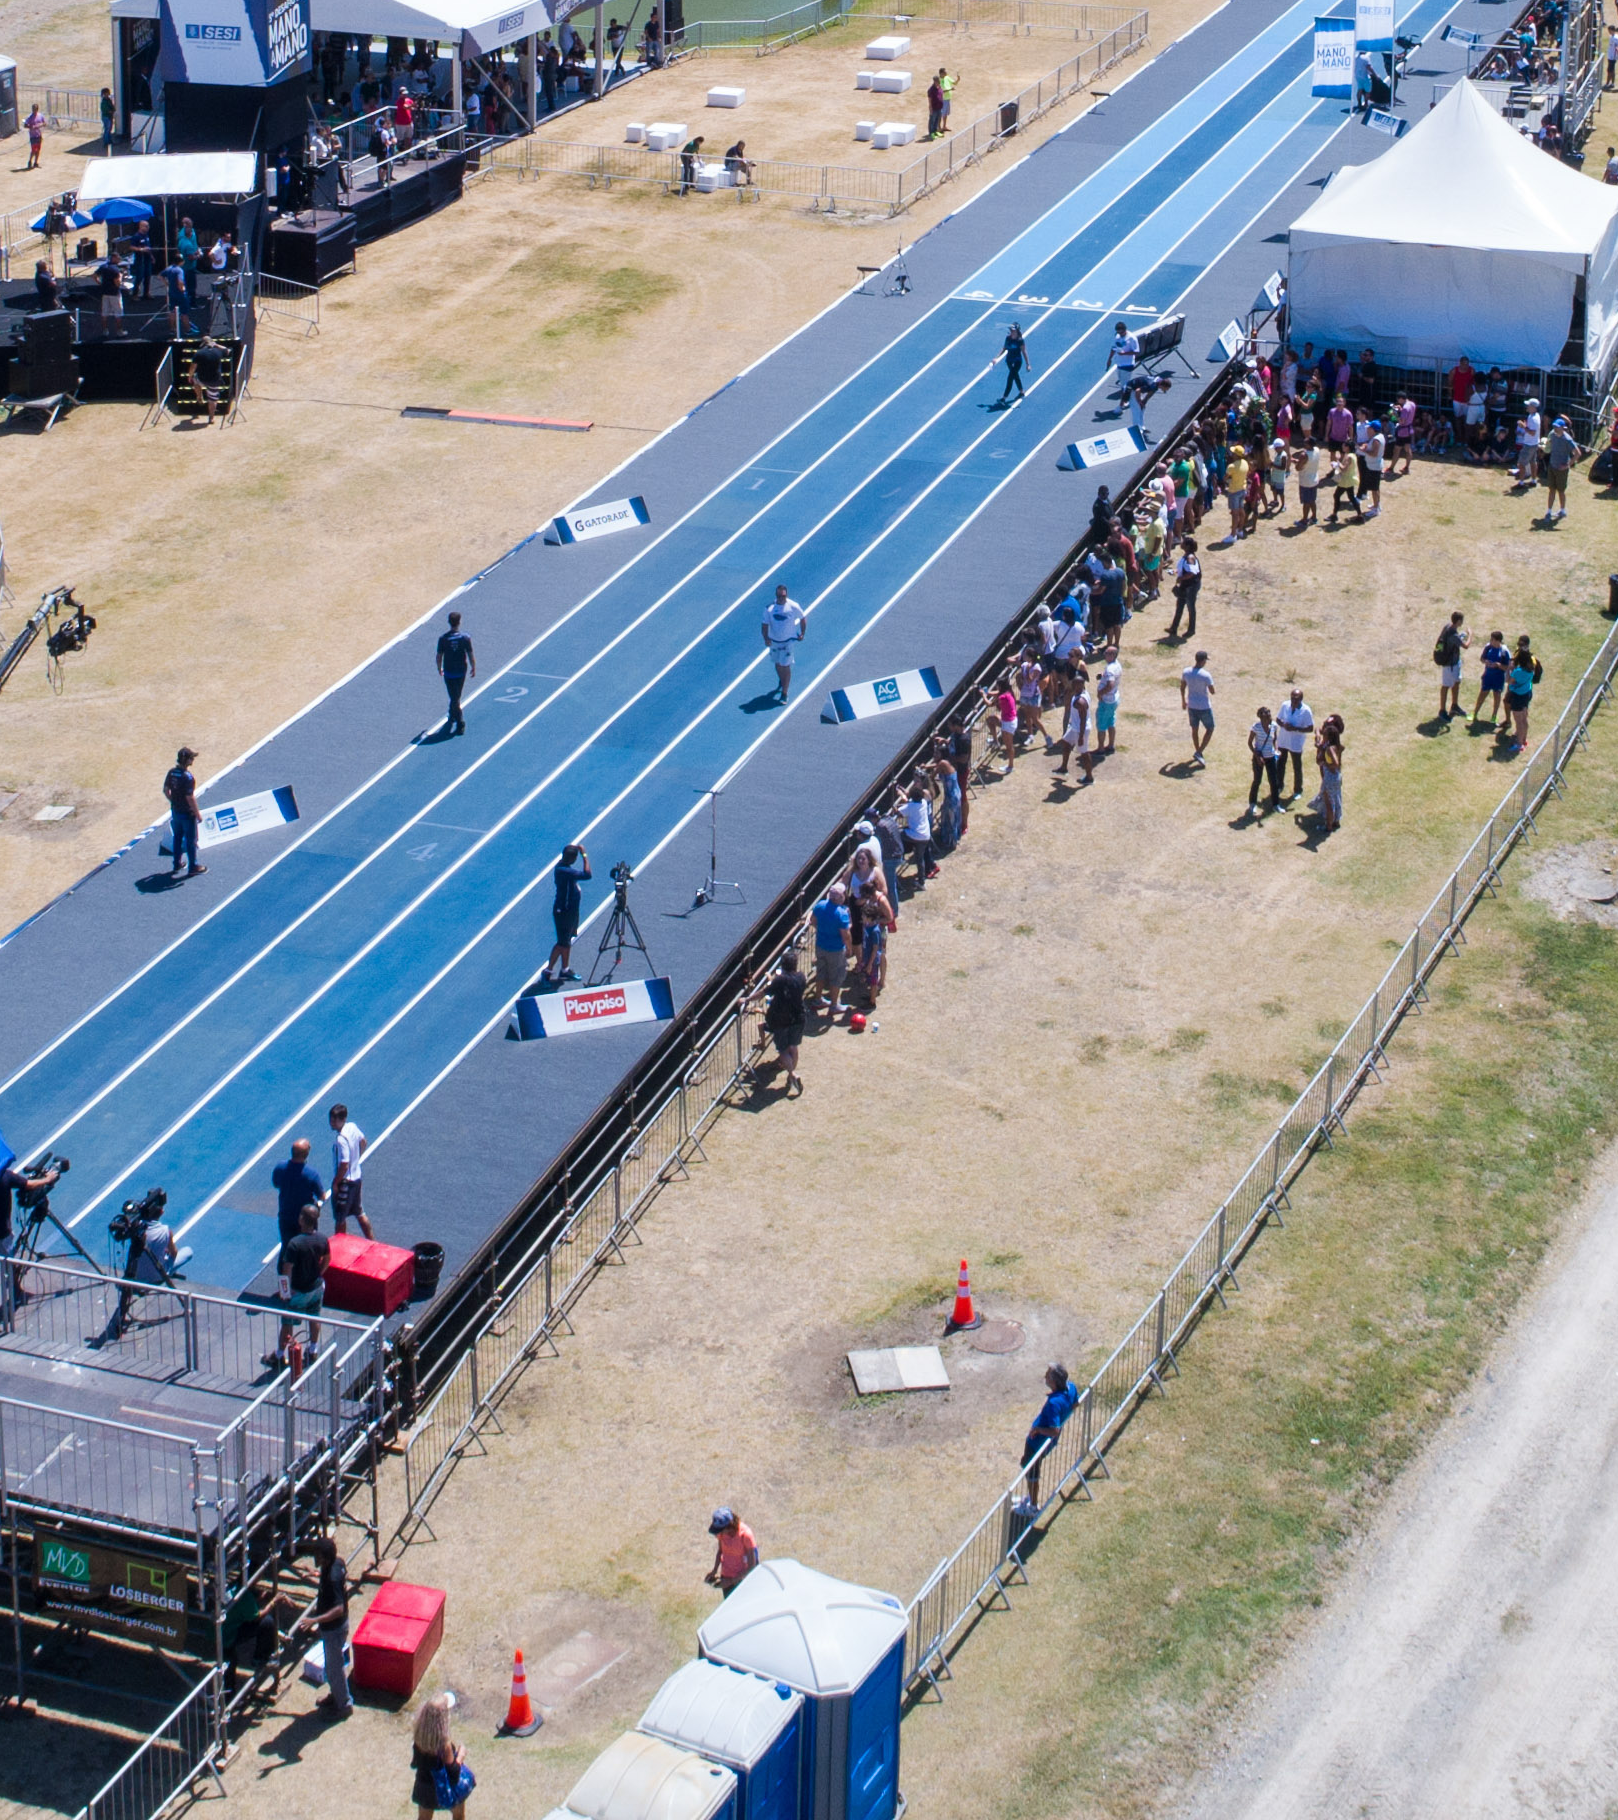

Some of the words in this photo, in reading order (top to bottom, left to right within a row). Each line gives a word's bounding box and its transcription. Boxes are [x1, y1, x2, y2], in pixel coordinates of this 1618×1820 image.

[204, 27, 239, 40] SESI
[268, 3, 301, 49] MANO
[275, 23, 308, 69] MANO
[1316, 47, 1346, 59] MANO
[1322, 56, 1351, 69] MANO
[1018, 294, 1049, 303] 3
[1071, 299, 1104, 308] 2
[584, 509, 629, 528] GATORADE
[493, 686, 529, 703] 2
[877, 681, 897, 696] AC
[565, 993, 625, 1016] Playpiso
[45, 1547, 86, 1578] MVD
[109, 1583, 185, 1613] LOSBERGER
[45, 1599, 179, 1638] www.mvdlosberger.com.br
